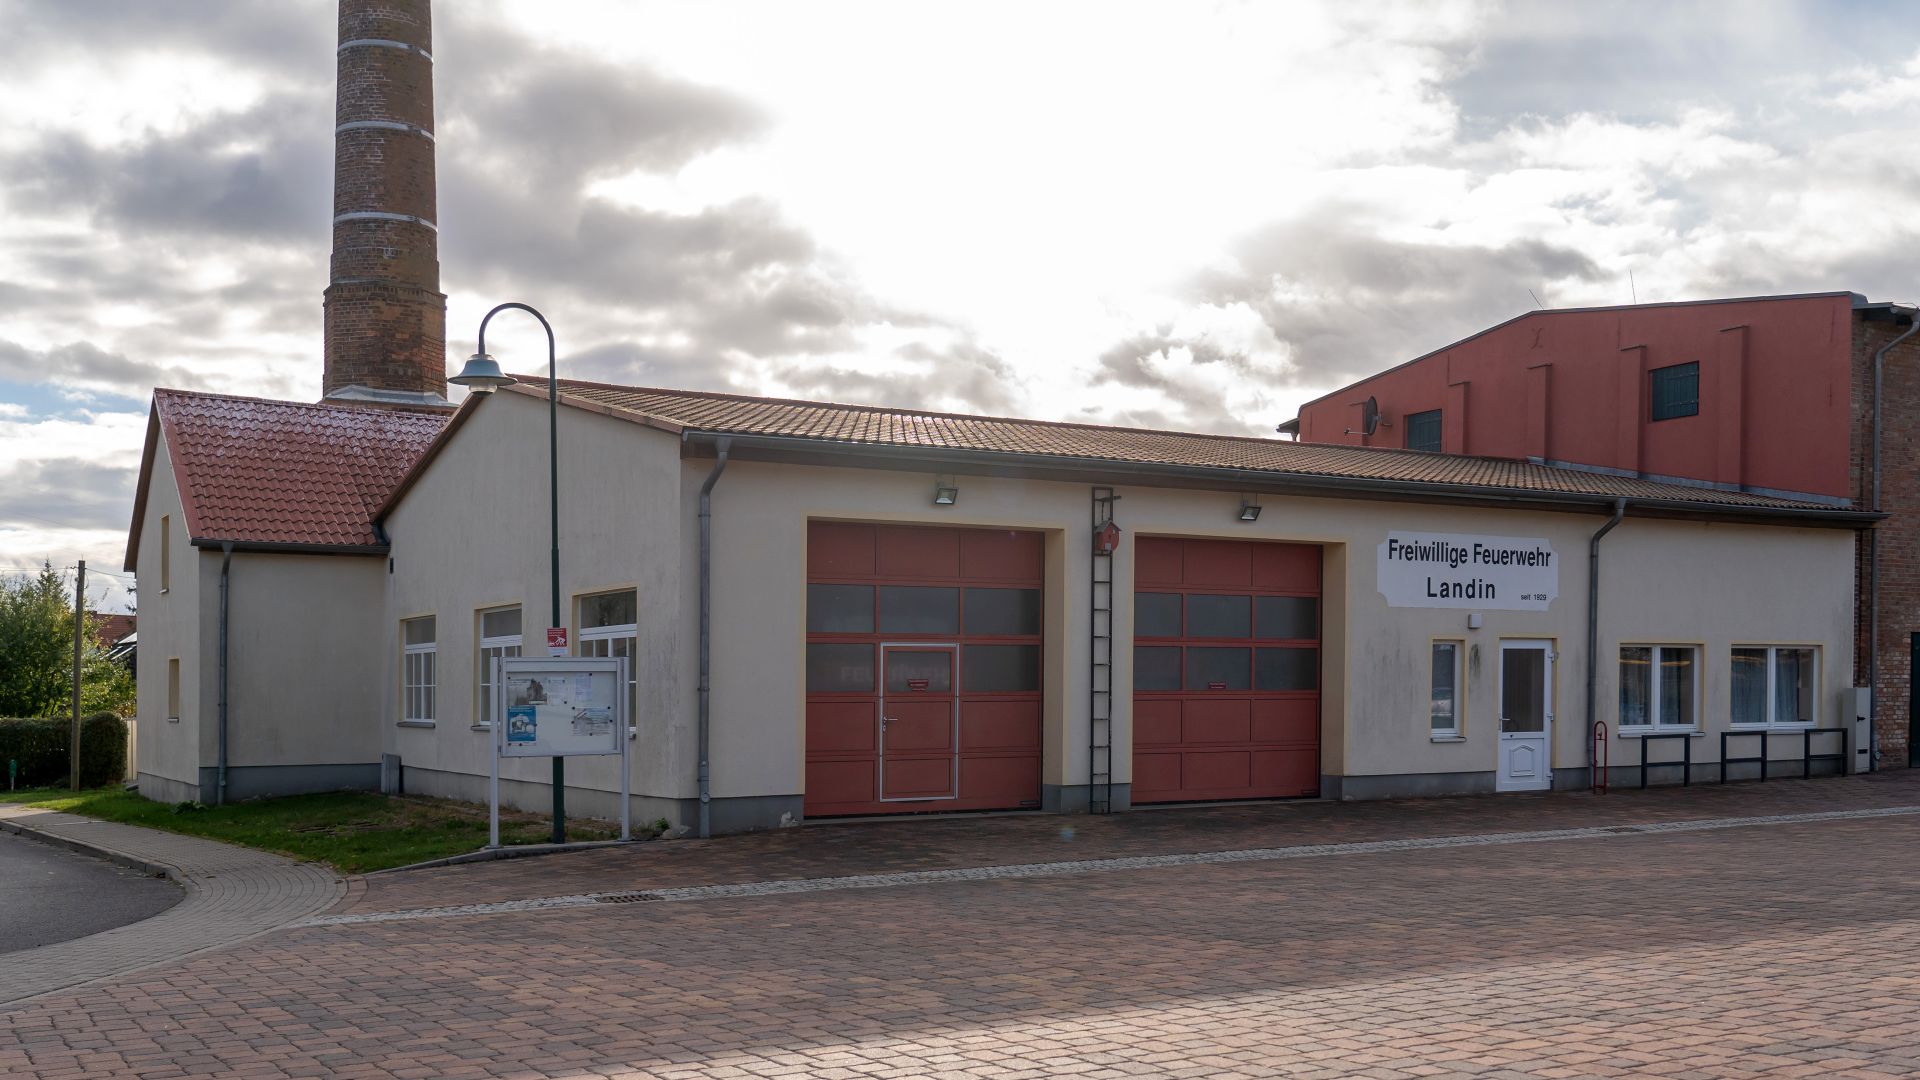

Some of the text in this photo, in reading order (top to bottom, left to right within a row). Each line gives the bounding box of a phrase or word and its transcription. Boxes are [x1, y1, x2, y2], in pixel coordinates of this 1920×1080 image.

[1388, 538, 1552, 568] Freiwillige Feuerwehr
[1427, 576, 1496, 600] Landin
[1533, 593, 1547, 601] 1929
